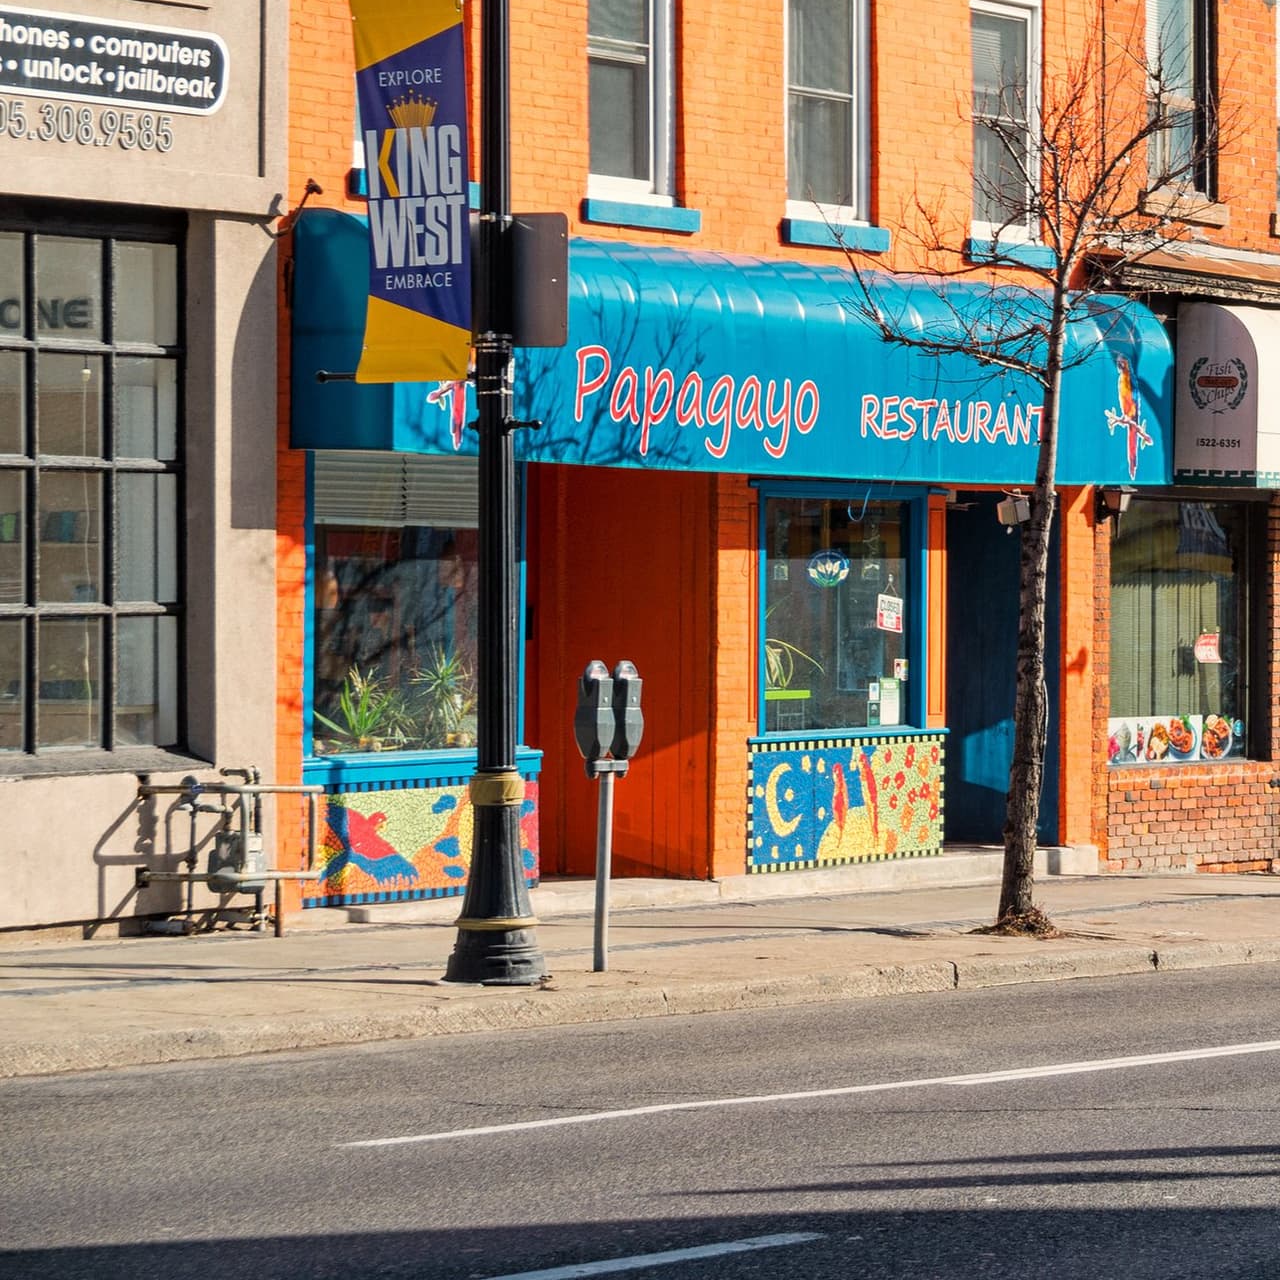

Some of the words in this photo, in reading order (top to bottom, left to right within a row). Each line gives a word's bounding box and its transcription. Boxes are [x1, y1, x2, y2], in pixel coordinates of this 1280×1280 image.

[90, 35, 212, 69] computers
[23, 57, 105, 86] unlock
[115, 65, 218, 99] jailbreak
[378, 68, 442, 87] EXPLORE
[365, 124, 463, 199] KING
[367, 195, 466, 269] WEST
[385, 272, 453, 290] EMBRACE
[575, 345, 820, 458] Papagayo
[861, 394, 1045, 446] RESTAURANT
